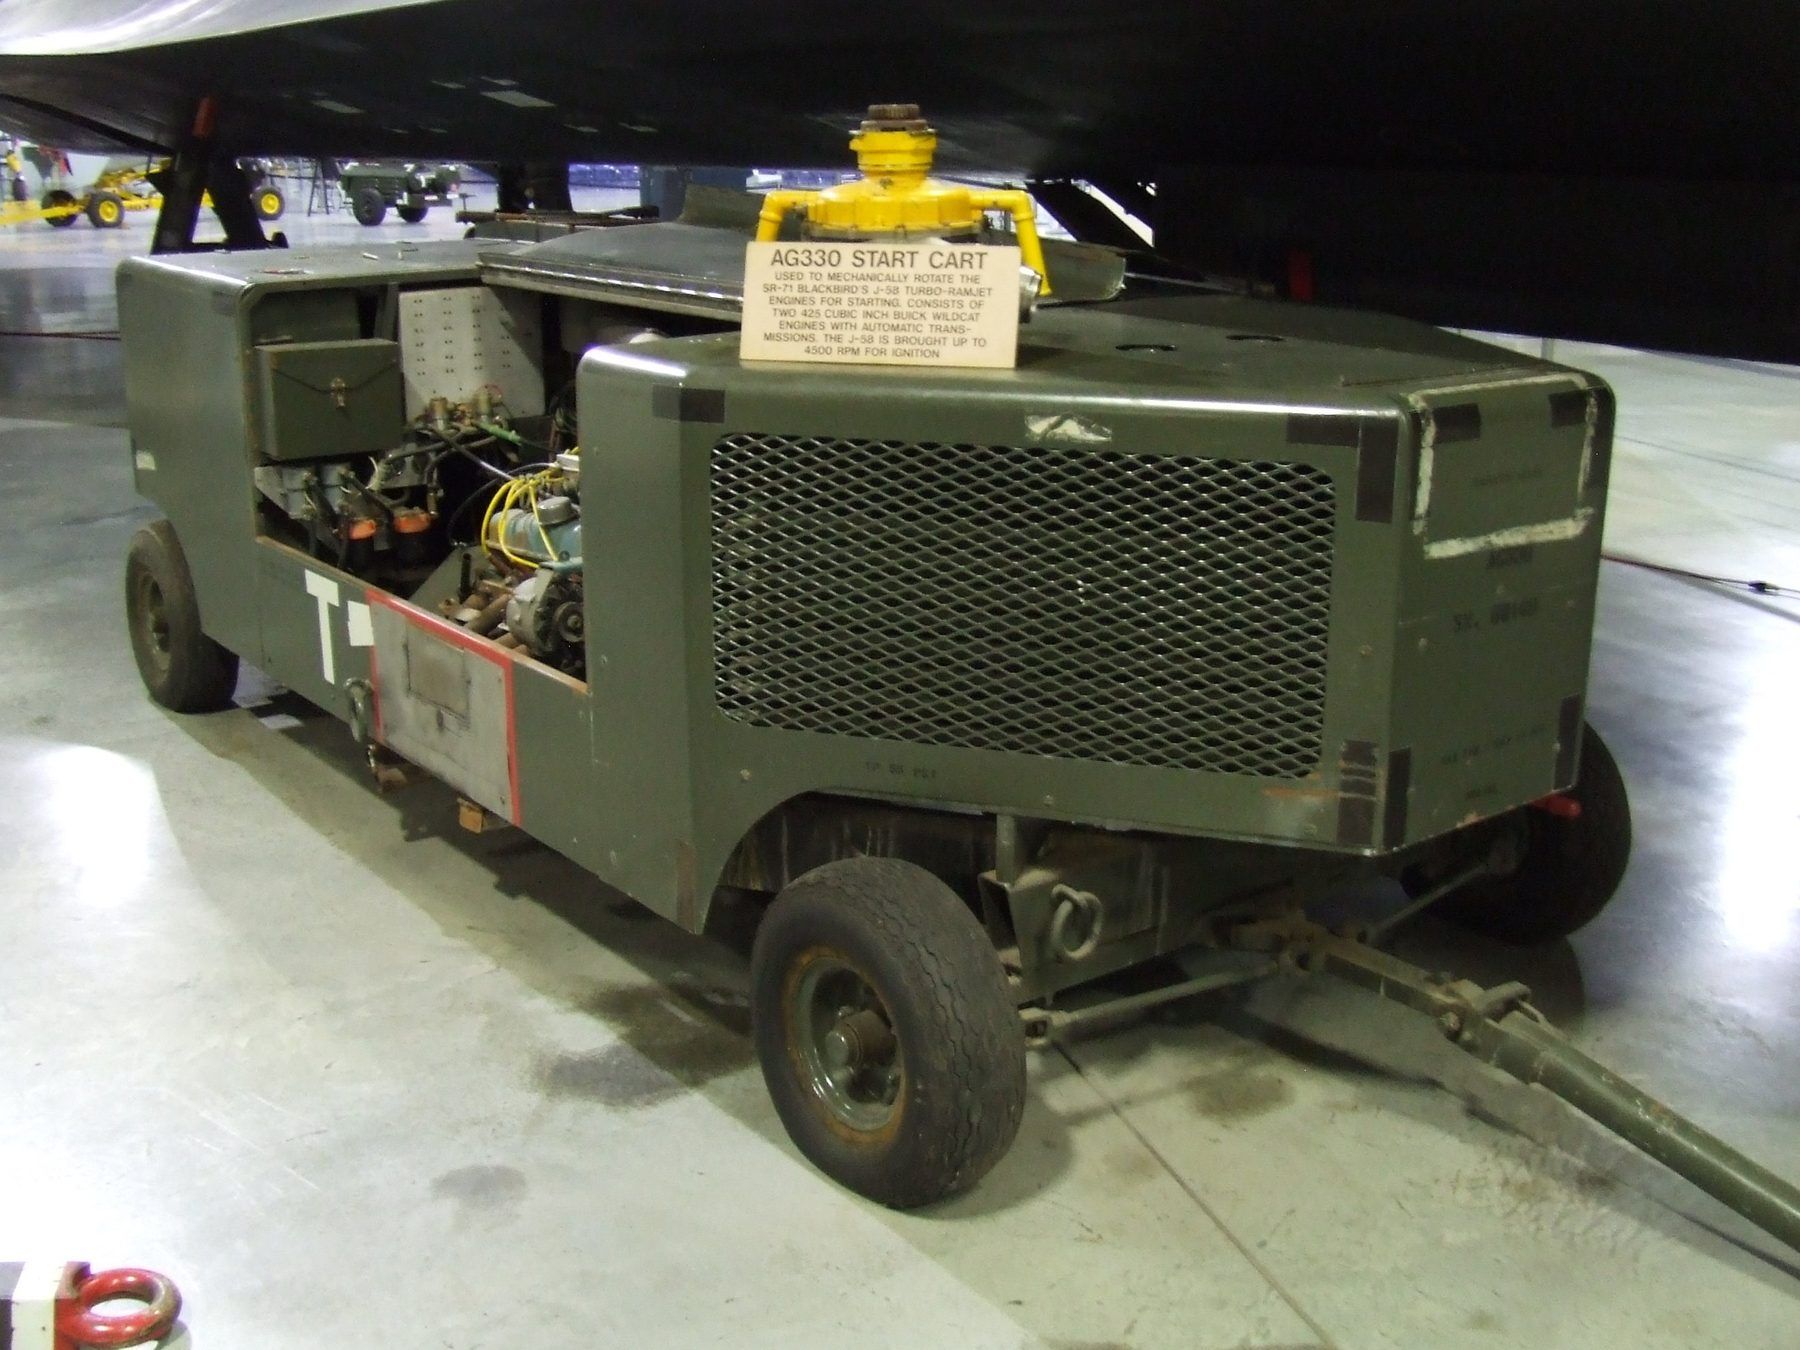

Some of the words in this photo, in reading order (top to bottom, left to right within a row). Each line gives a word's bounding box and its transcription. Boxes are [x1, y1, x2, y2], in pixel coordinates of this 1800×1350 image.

[770, 249, 841, 267] AG330
[851, 250, 919, 268] START
[929, 251, 988, 269] CART
[775, 271, 804, 281] USED
[809, 272, 823, 281] TO
[827, 272, 909, 283] MECHANICALLY
[914, 273, 954, 283] ROTATE
[960, 274, 981, 284] THE
[763, 283, 793, 293] SR-71
[873, 286, 900, 295] J-58
[905, 286, 993, 297] TURBO-RAMJET
[769, 295, 816, 306] ENGINES
[820, 297, 842, 306] FOR
[907, 299, 964, 309] CONSISTS
[969, 300, 985, 309] OF
[773, 308, 797, 317] TWO
[801, 308, 821, 318] 425
[824, 309, 857, 319] CUBIC
[862, 310, 889, 319] INCH
[893, 310, 927, 321] BUICK
[932, 312, 981, 322] WILDCAT
[779, 320, 826, 331] ENGINES
[830, 321, 857, 331] WITH
[862, 322, 923, 333] AUTOMATIC
[929, 324, 972, 334] TRANS-
[823, 333, 844, 343] THE
[848, 334, 875, 344] J-58
[879, 335, 889, 345] IS
[894, 335, 947, 346] BROUGHT
[953, 337, 968, 347] UP
[972, 338, 986, 347] TO
[804, 346, 833, 356] 4500
[837, 346, 860, 356] RPM
[865, 347, 887, 357] FOR
